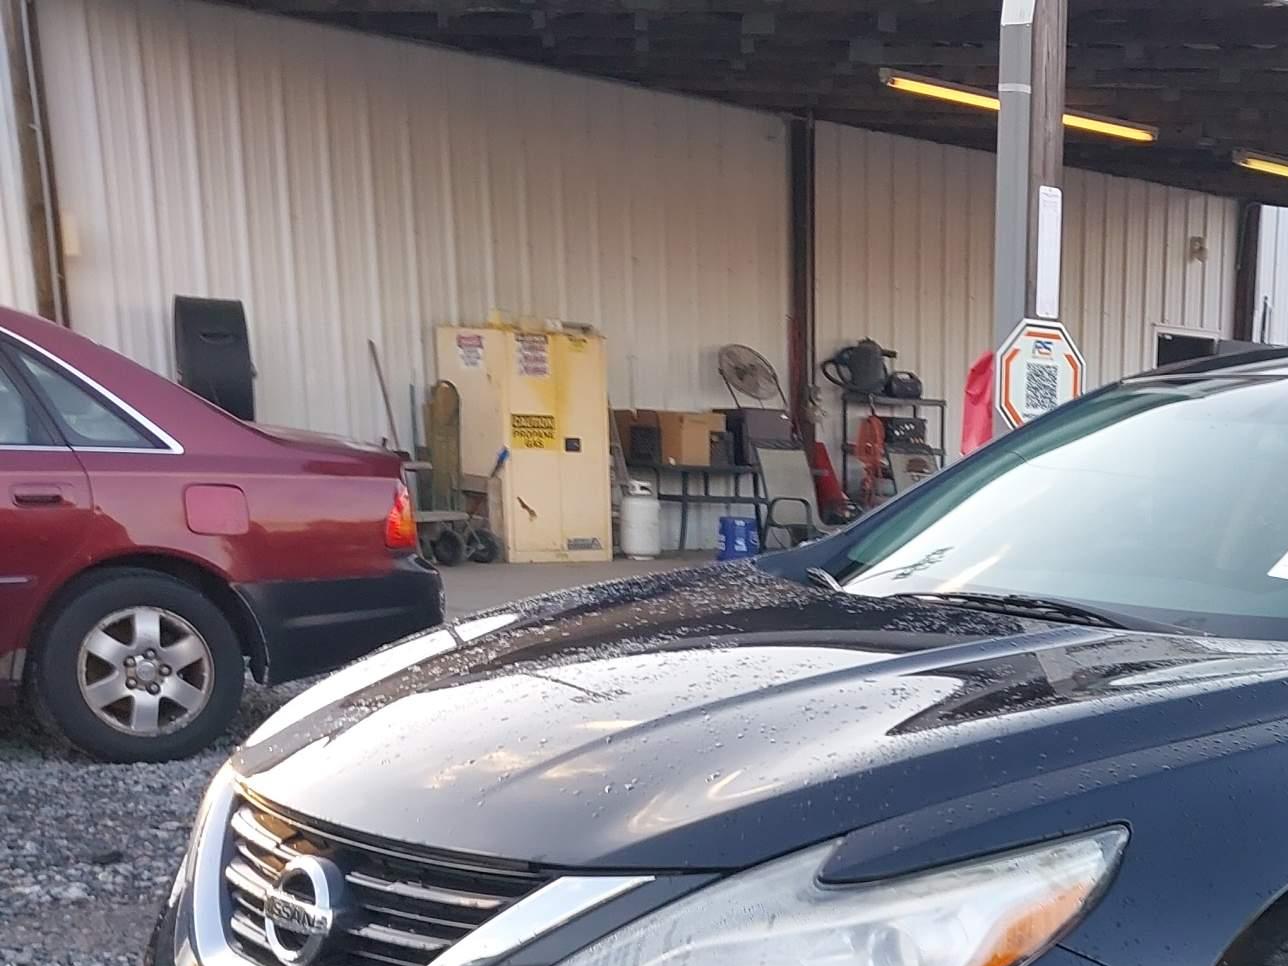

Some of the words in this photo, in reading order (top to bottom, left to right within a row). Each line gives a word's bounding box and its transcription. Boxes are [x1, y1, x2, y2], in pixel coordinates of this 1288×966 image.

[512, 416, 553, 428] CAUTION
[513, 430, 554, 439] PROPANE
[525, 440, 545, 449] GAS
